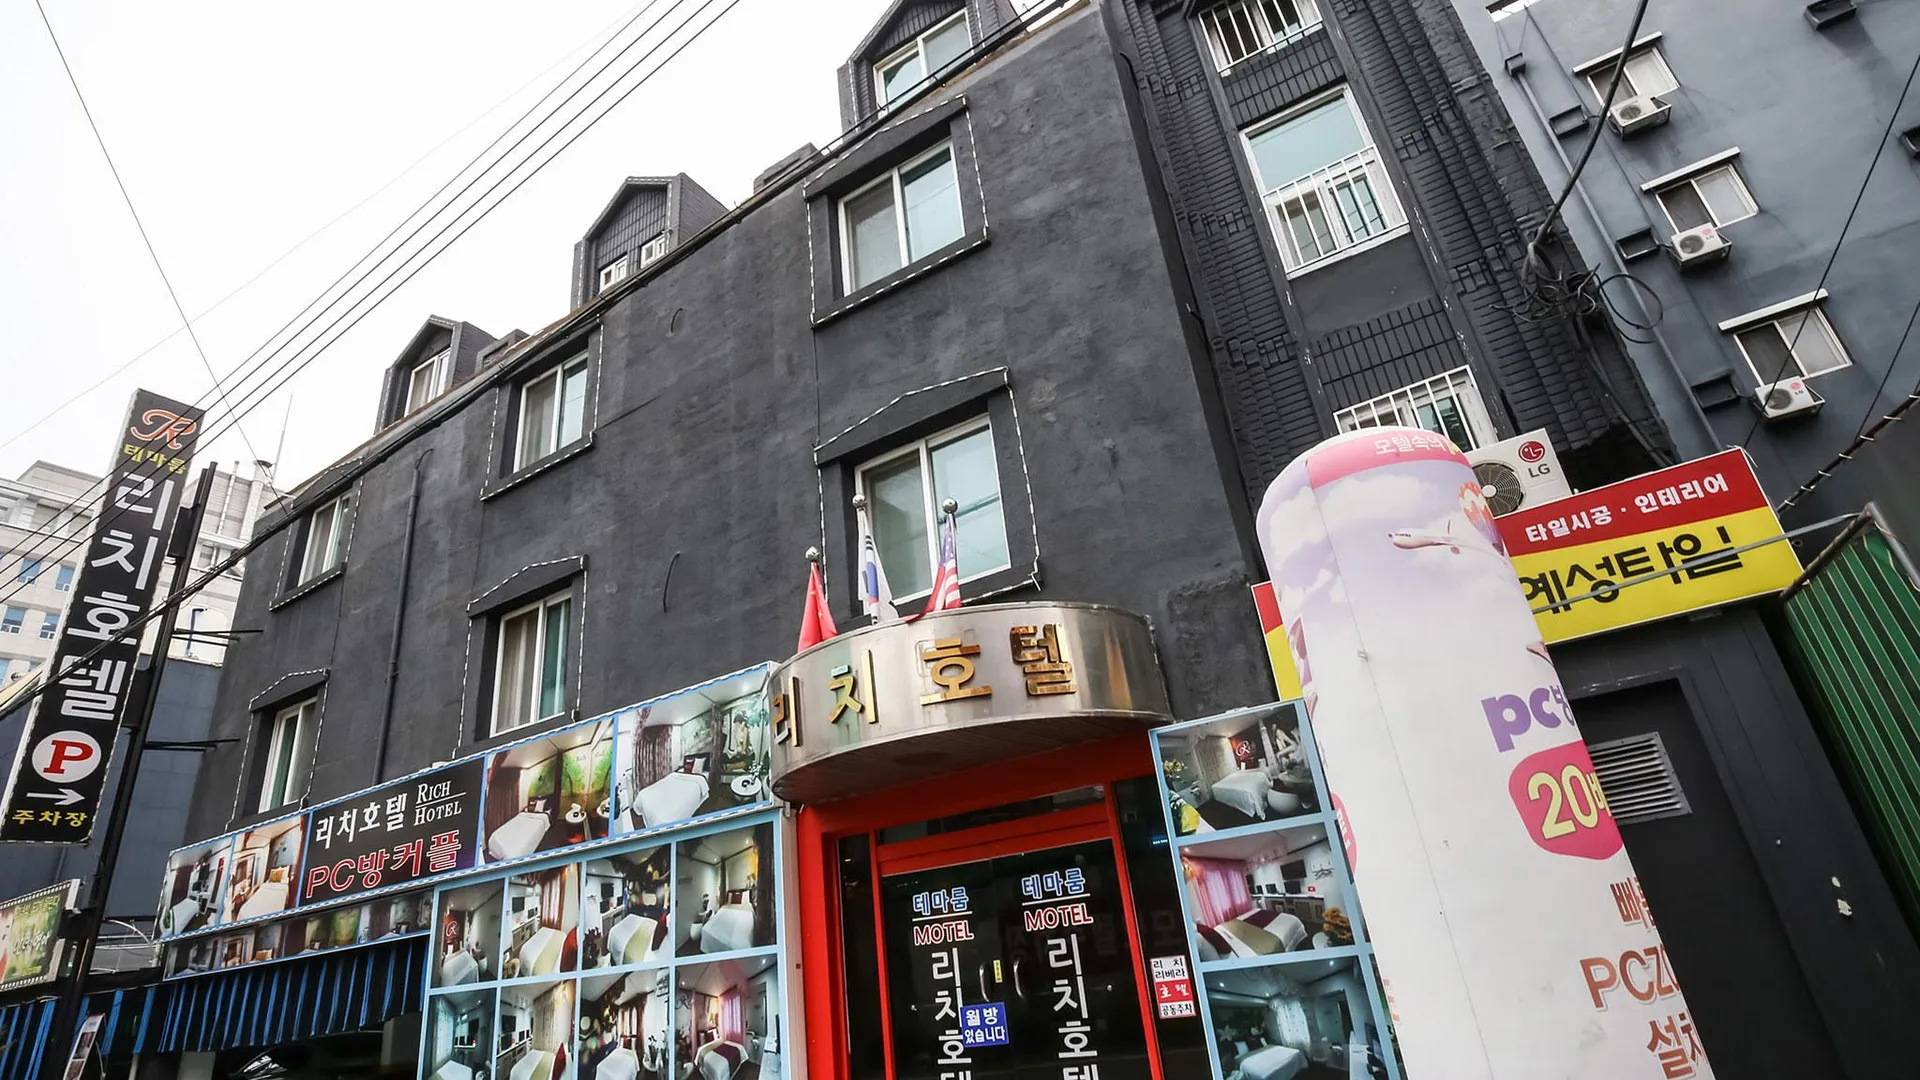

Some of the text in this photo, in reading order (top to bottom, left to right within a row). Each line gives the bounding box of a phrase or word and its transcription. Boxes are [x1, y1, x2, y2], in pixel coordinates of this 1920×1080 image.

[123, 443, 187, 474] 테마룸
[1528, 463, 1551, 479] LG
[1525, 473, 1729, 543] 타일시공 인테리어
[1519, 526, 1743, 615] 예성타일
[59, 470, 175, 721] 리치호텔
[772, 623, 1078, 747] 리치호텔
[415, 780, 452, 806] RICH
[12, 808, 88, 828] 주차장
[315, 793, 408, 850] 리치호텔
[413, 801, 463, 827] HOTEL
[306, 830, 462, 899] PC방커플
[1021, 867, 1086, 899] 테마룸
[912, 886, 969, 916] 테마룸
[1024, 902, 1094, 932] MOTEL
[913, 919, 975, 946] MOTEL
[1155, 968, 1186, 980] 리베라
[1161, 1003, 1193, 1017] 공동주차
[964, 1026, 1006, 1045] 있습니다
